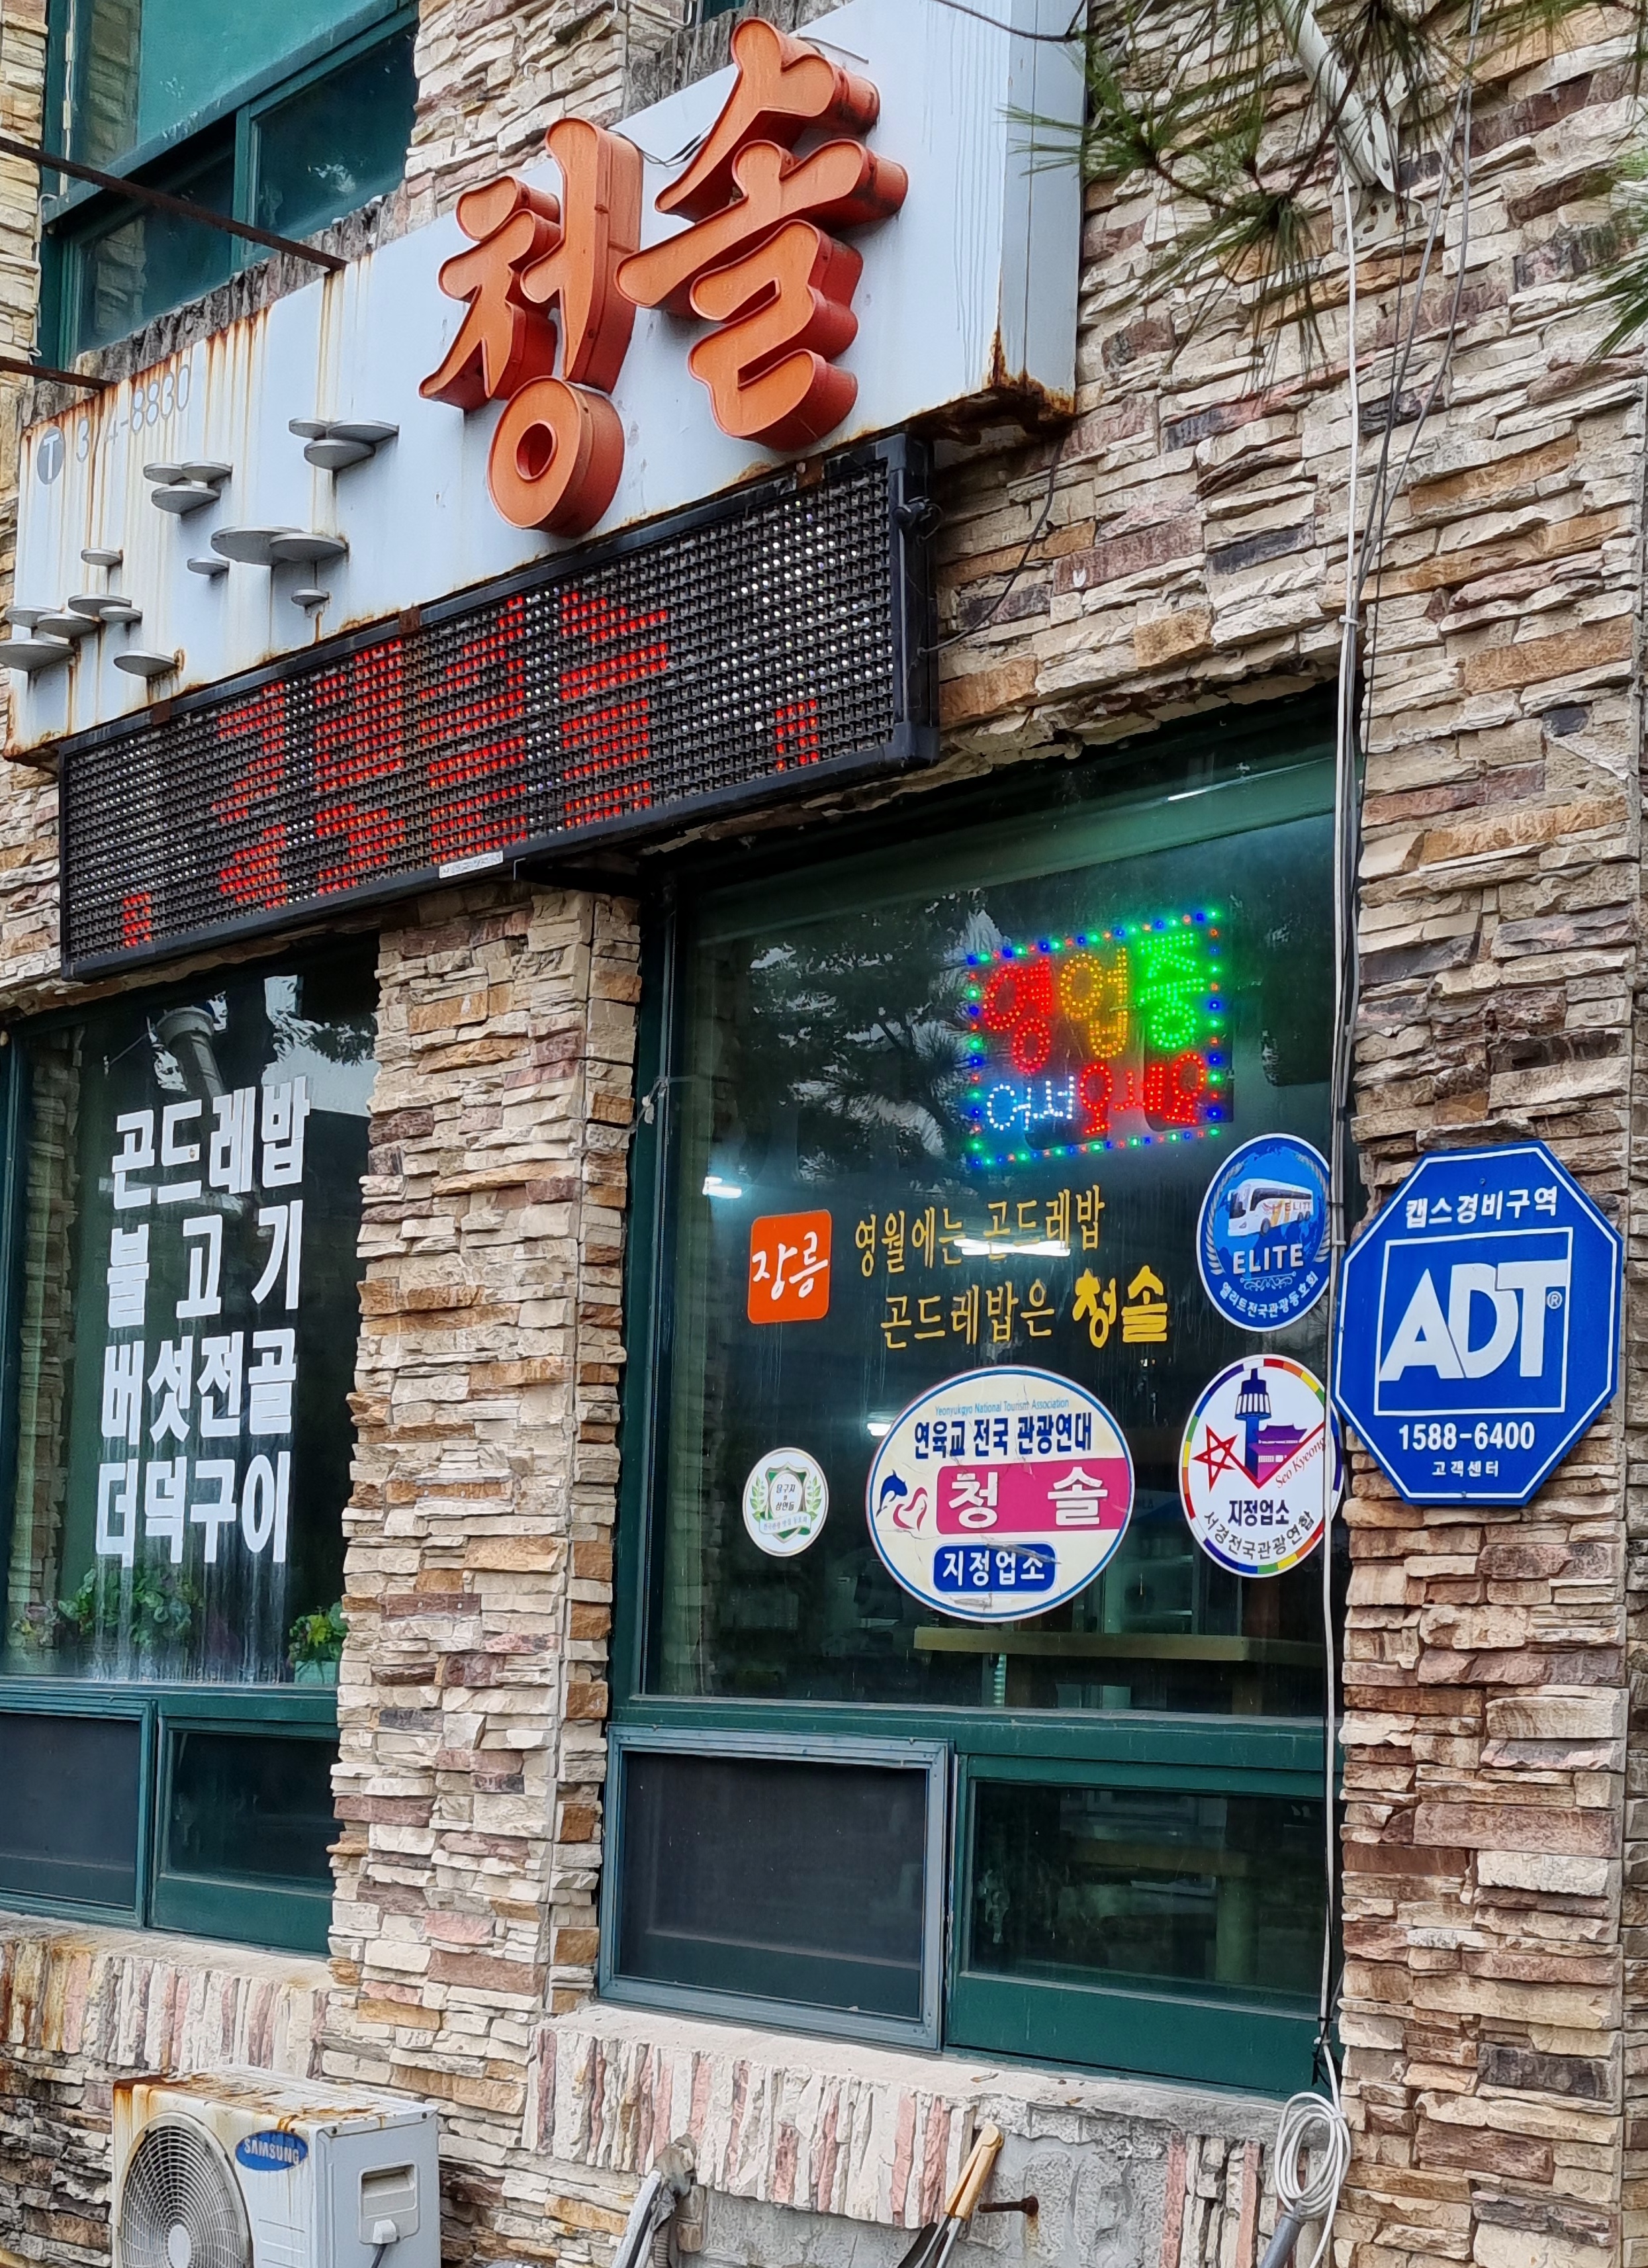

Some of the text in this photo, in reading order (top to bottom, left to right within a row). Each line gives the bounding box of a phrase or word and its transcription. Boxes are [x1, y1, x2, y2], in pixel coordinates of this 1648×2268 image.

[419, 17, 901, 536] 청솔
[982, 932, 1206, 1073] 영업중
[112, 1076, 310, 1210] 곤드레밥
[855, 1184, 1105, 1277] 영월에는 곤드레밥
[1406, 1186, 1557, 1229] 캡스경비구역
[107, 1200, 303, 1328] 불고기
[752, 1231, 829, 1301] 장릉
[1232, 1243, 1305, 1274] ELITE
[880, 1265, 1167, 1349] 곤드레밥은 청솔
[1379, 1259, 1569, 1382] ADT
[101, 1328, 297, 1446] 버섯전골
[935, 1397, 1070, 1417] Yeonyukgyo National Tourism Association
[914, 1411, 1092, 1460] 연육교 전국 관광연대
[1398, 1421, 1535, 1450] 1588-6400
[1275, 1437, 1326, 1489] Seo Kyeong
[1432, 1460, 1499, 1478] 고객센터
[95, 1450, 291, 1567] 더덕구이
[1228, 1499, 1290, 1527] 지정업소
[1204, 1510, 1315, 1560] 서경전국관광연합
[942, 1550, 1046, 1586] 지정업소
[244, 2138, 299, 2165] SAMSUNG
